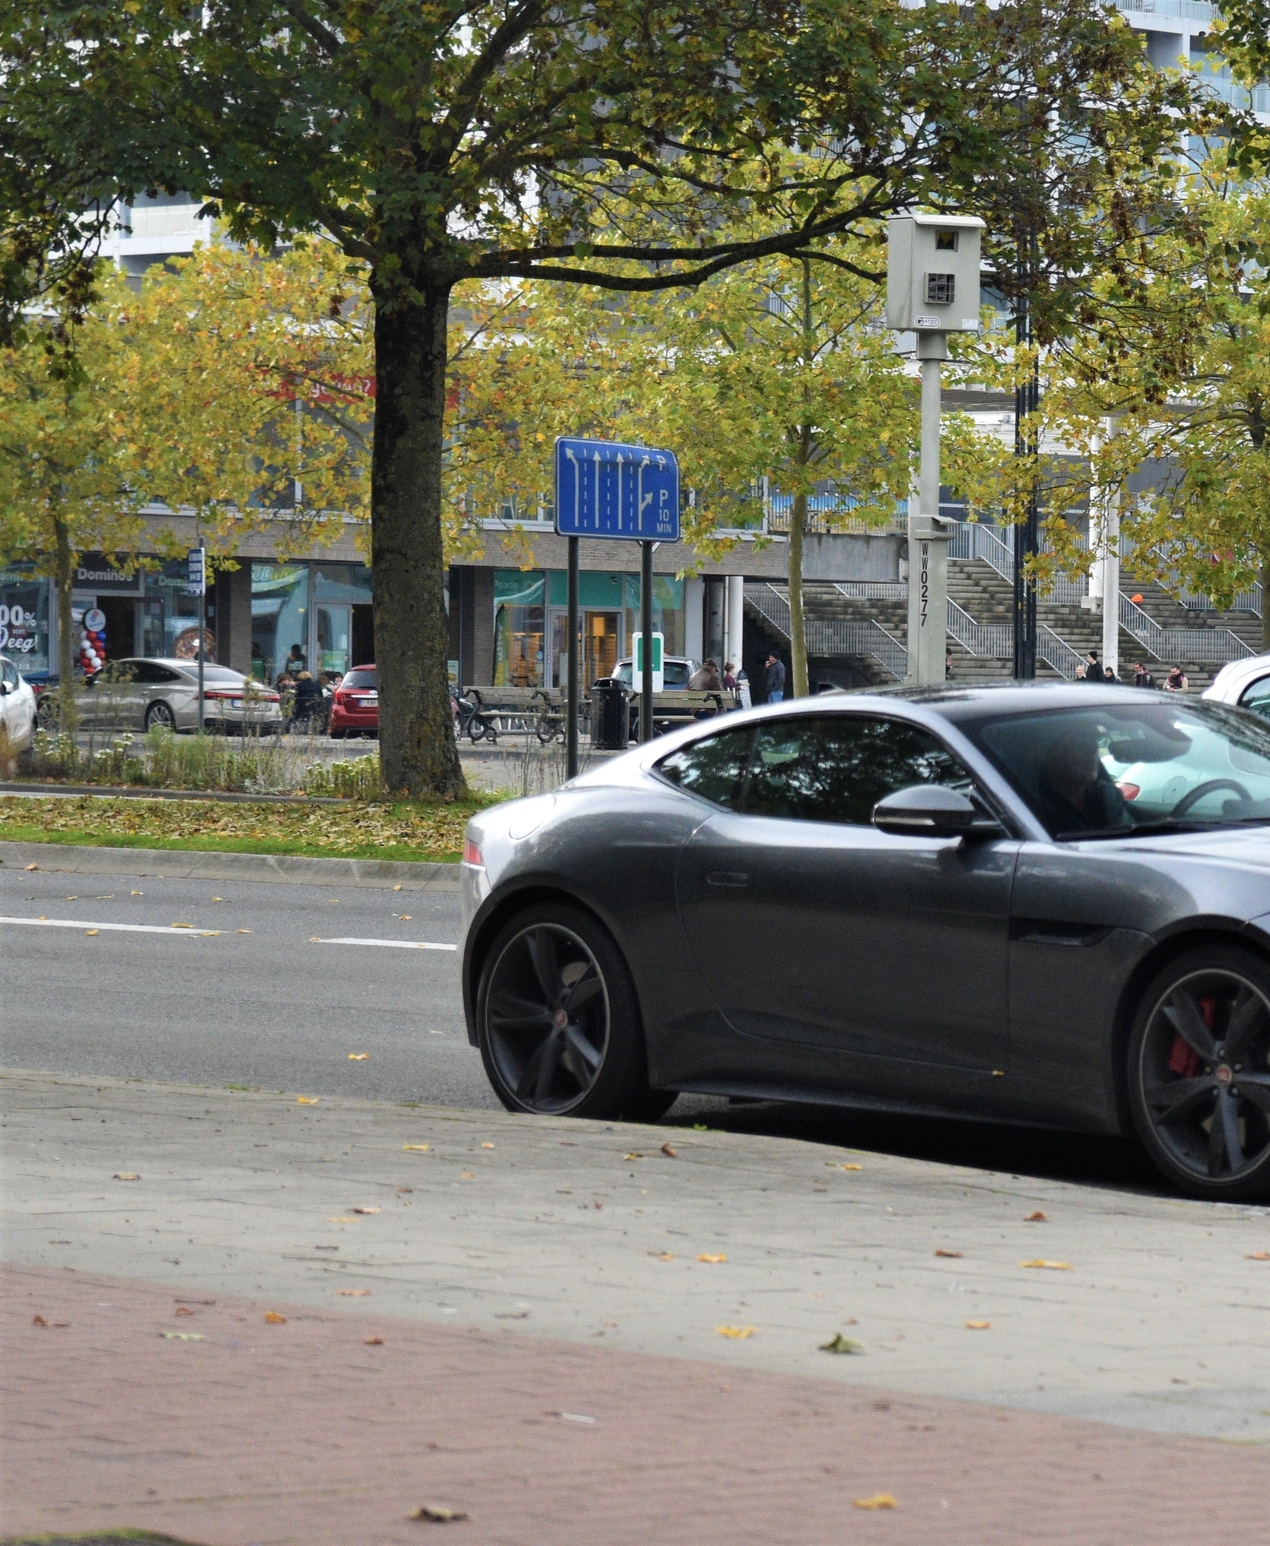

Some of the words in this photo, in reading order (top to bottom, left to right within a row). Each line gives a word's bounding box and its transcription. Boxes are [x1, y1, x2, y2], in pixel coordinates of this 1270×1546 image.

[655, 455, 666, 471] P
[659, 489, 668, 507] P
[658, 509, 669, 522] 10
[656, 522, 672, 534] MIN
